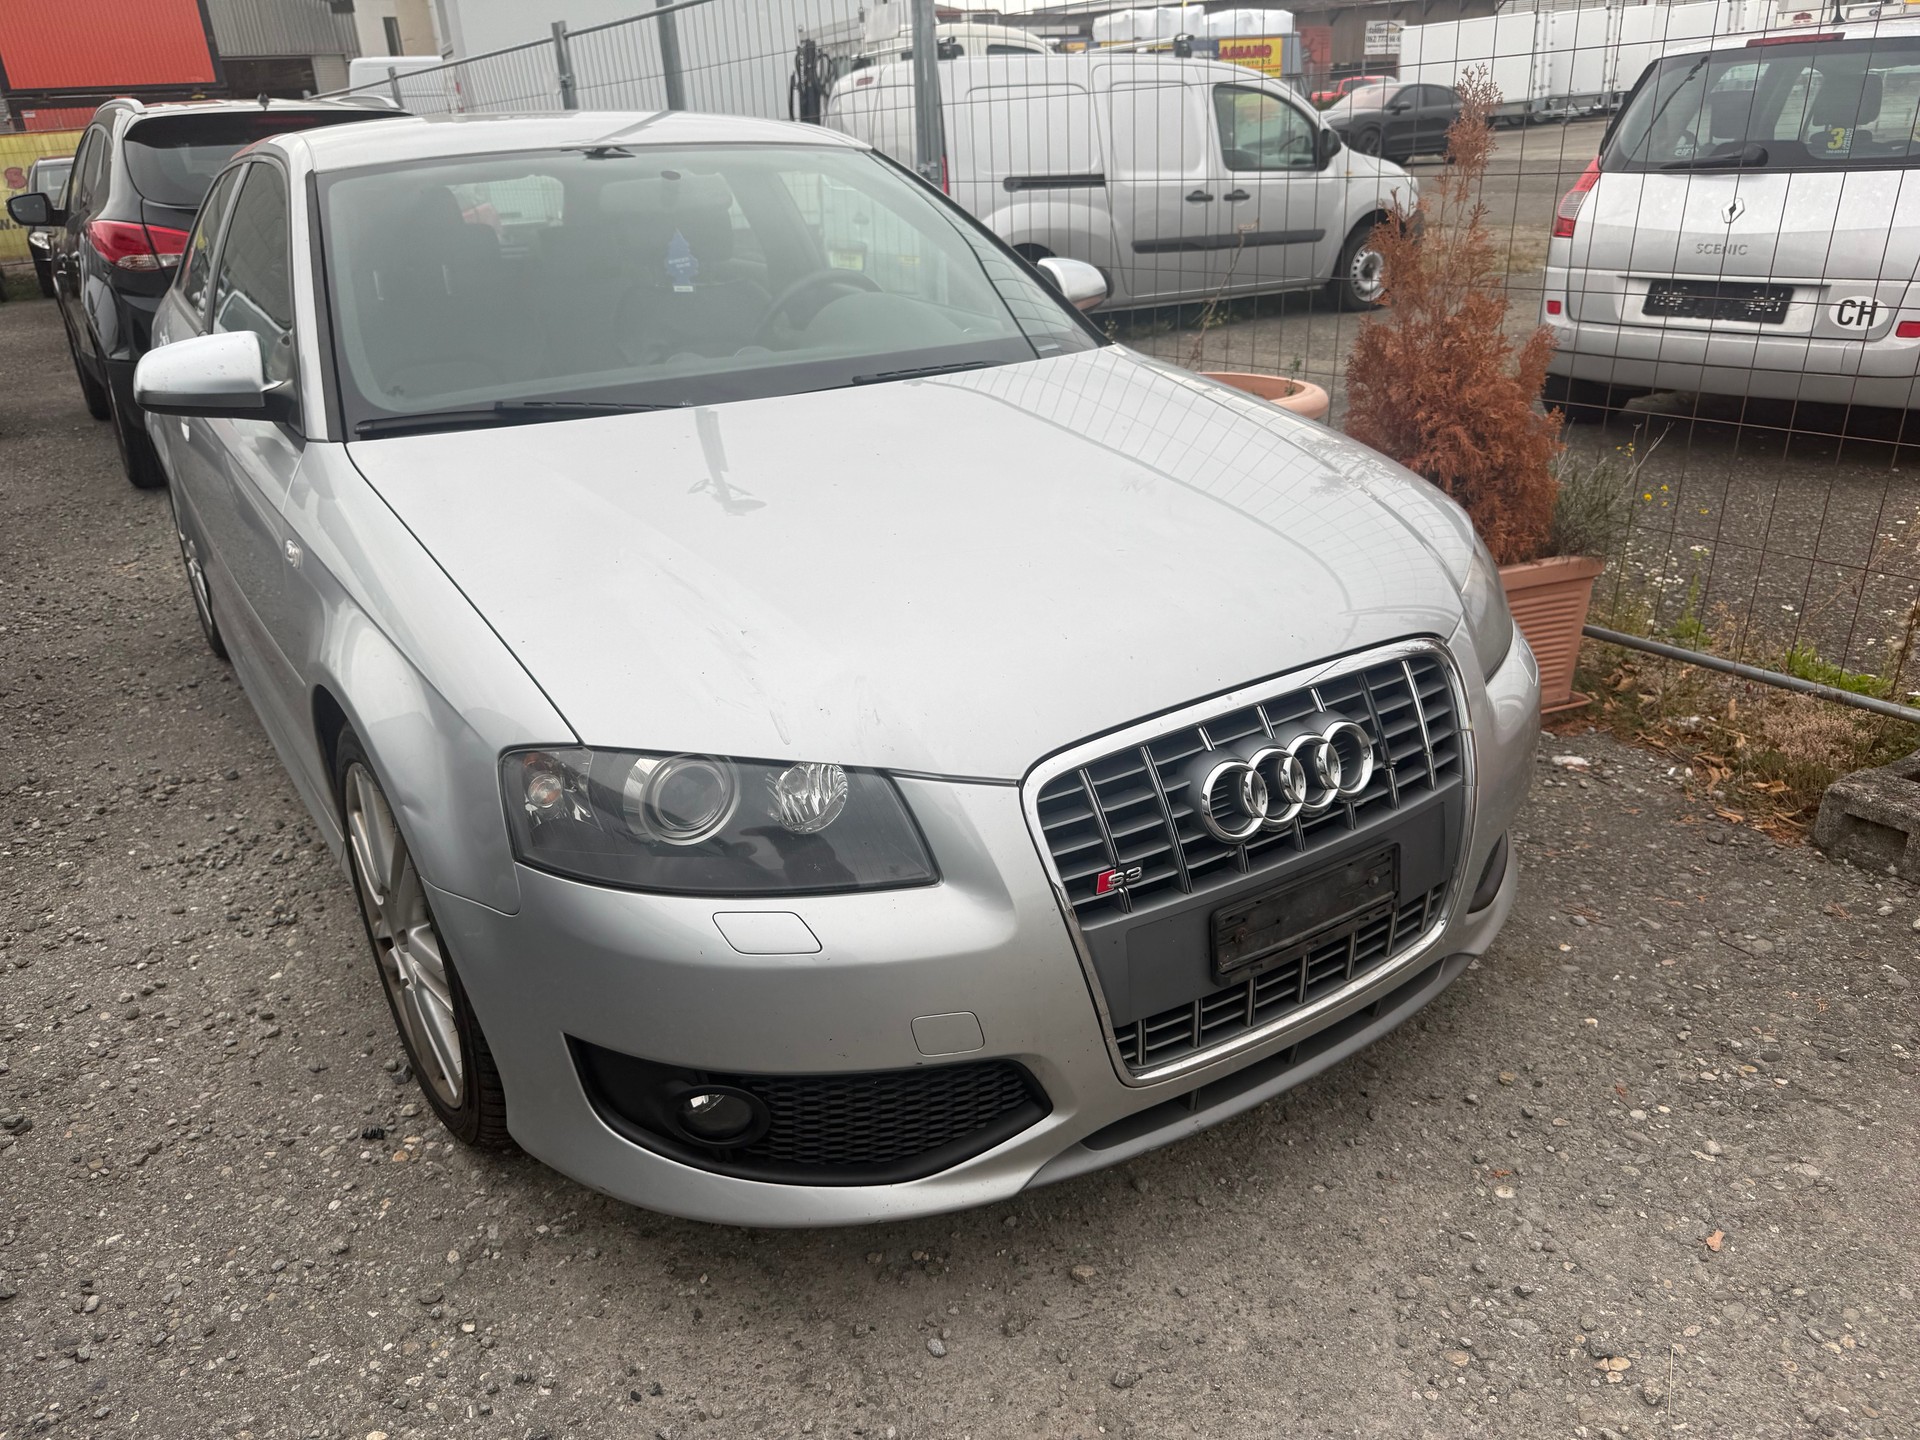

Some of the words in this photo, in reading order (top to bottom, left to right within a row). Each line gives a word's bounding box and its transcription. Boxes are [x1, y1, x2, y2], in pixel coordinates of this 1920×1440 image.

[1827, 127, 1845, 150] 3
[1695, 243, 1748, 256] SCENIC
[1837, 299, 1878, 327] CH
[1105, 866, 1142, 889] S3
